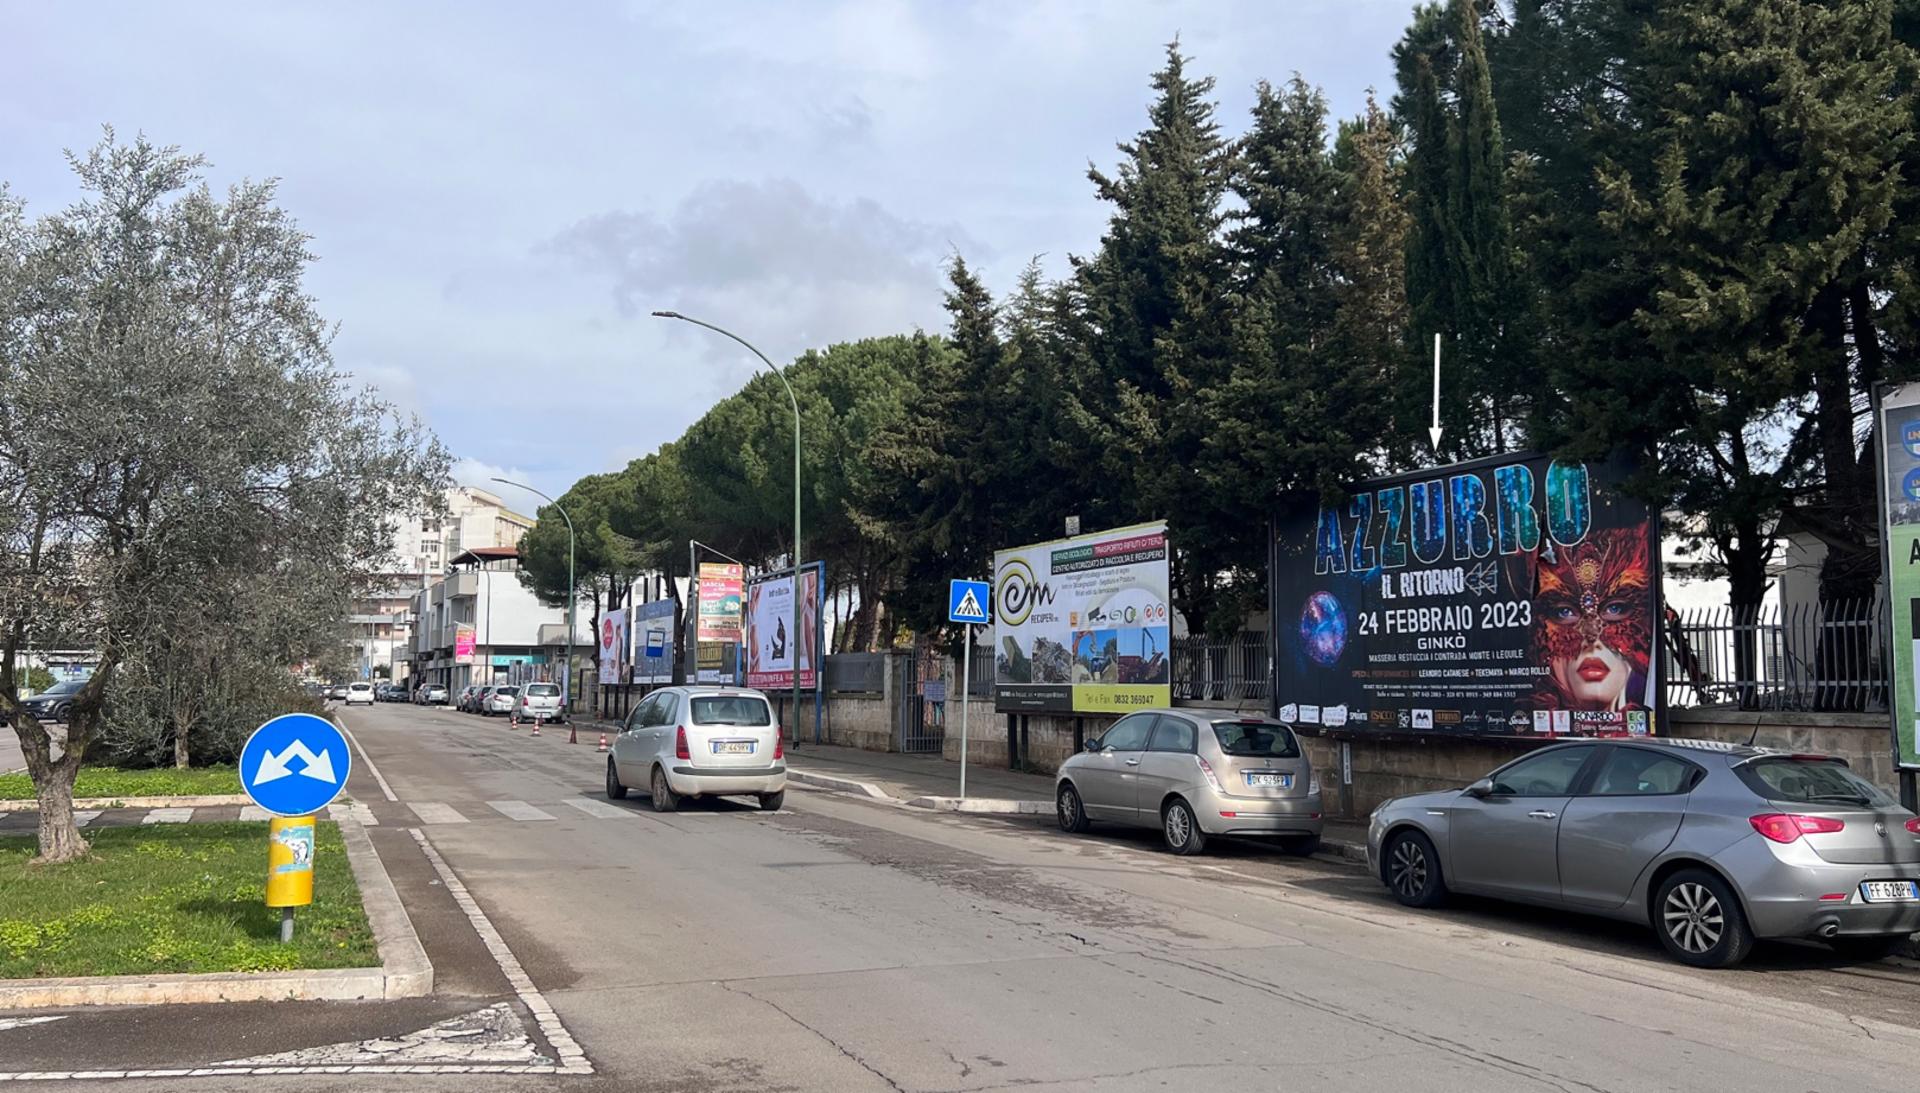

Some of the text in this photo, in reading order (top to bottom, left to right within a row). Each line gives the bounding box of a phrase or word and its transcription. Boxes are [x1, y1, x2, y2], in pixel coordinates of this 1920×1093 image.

[1315, 459, 1592, 575] AZZURRO
[1135, 550, 1164, 561] RECUPERO
[1381, 566, 1465, 599] IL RITORNO
[1358, 600, 1532, 635] 24 FEBBRAIO 2023
[1417, 632, 1466, 650] GINKÒ
[1368, 653, 1397, 662] MASSERIA
[1434, 651, 1467, 661] CONTRADA
[1869, 884, 1880, 897] FF
